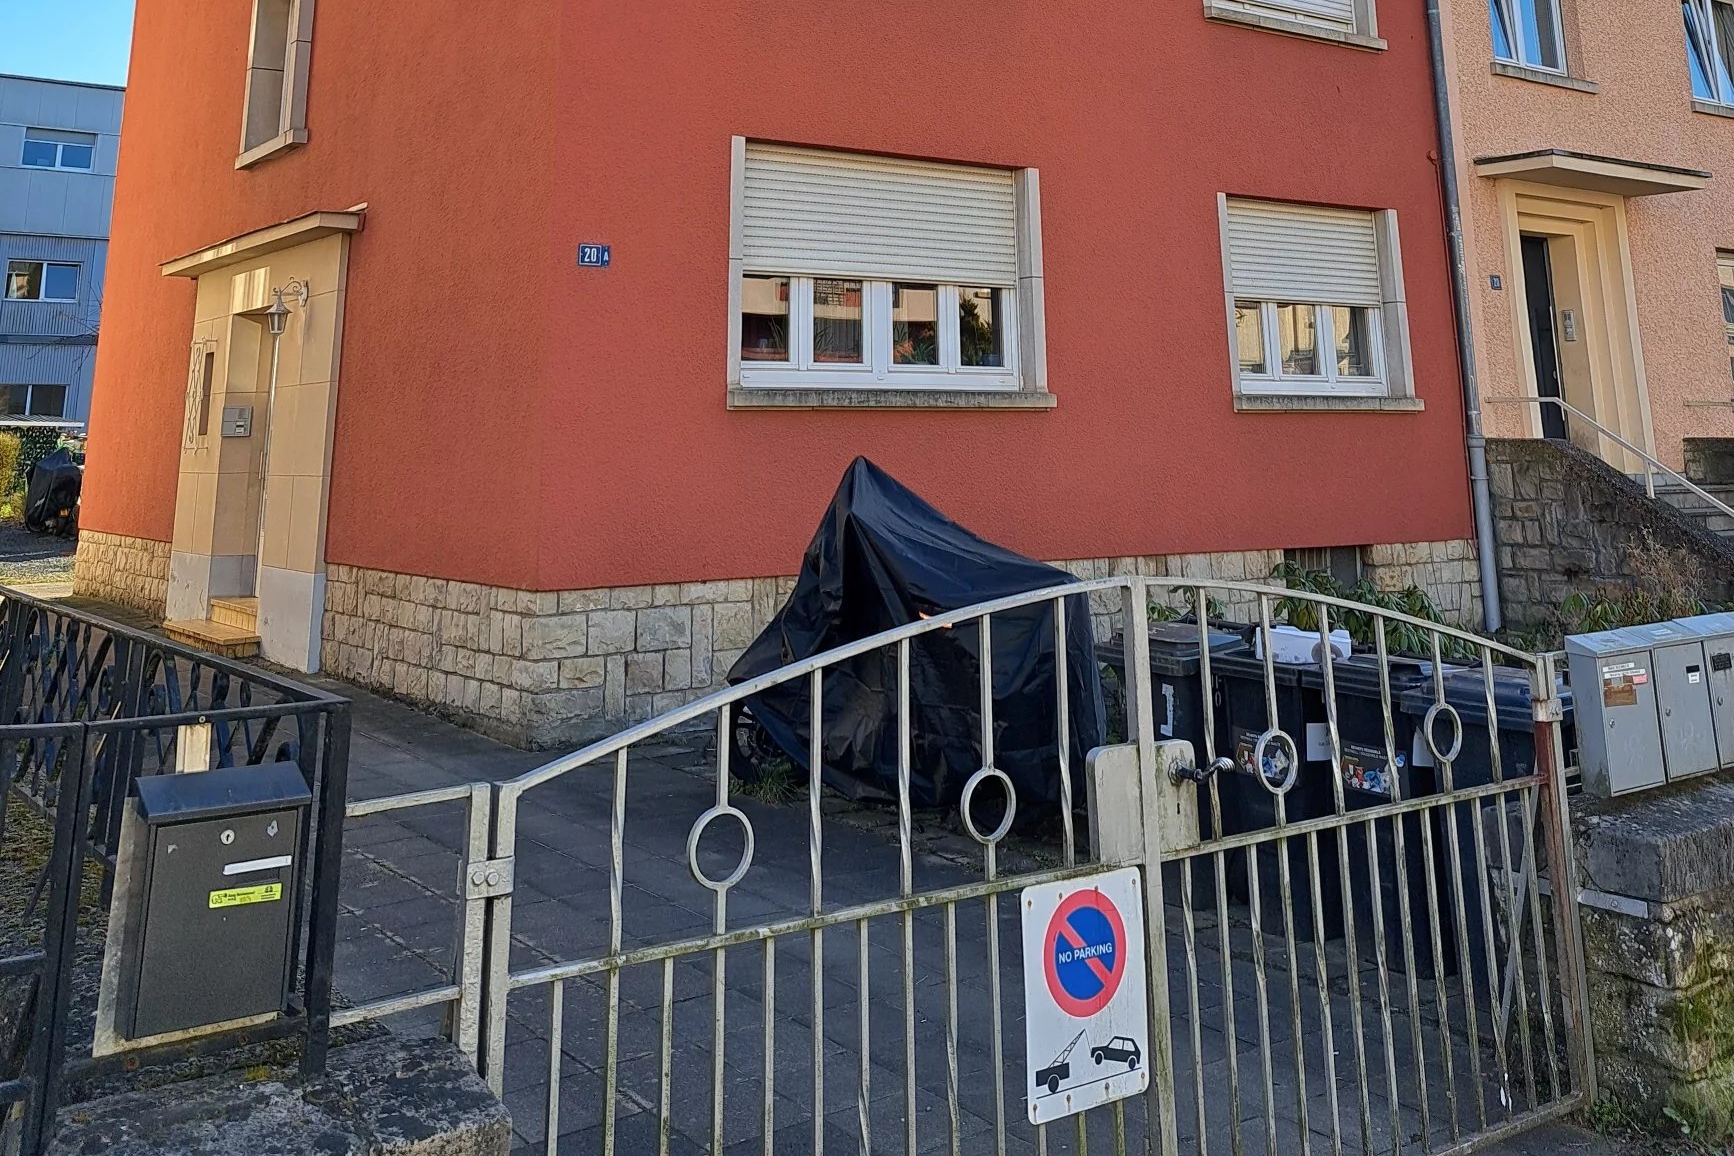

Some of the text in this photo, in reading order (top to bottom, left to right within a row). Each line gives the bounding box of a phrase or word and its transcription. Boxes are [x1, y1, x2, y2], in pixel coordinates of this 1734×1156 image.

[584, 247, 609, 262] 20 A
[1059, 942, 1113, 964] NO PARKING
